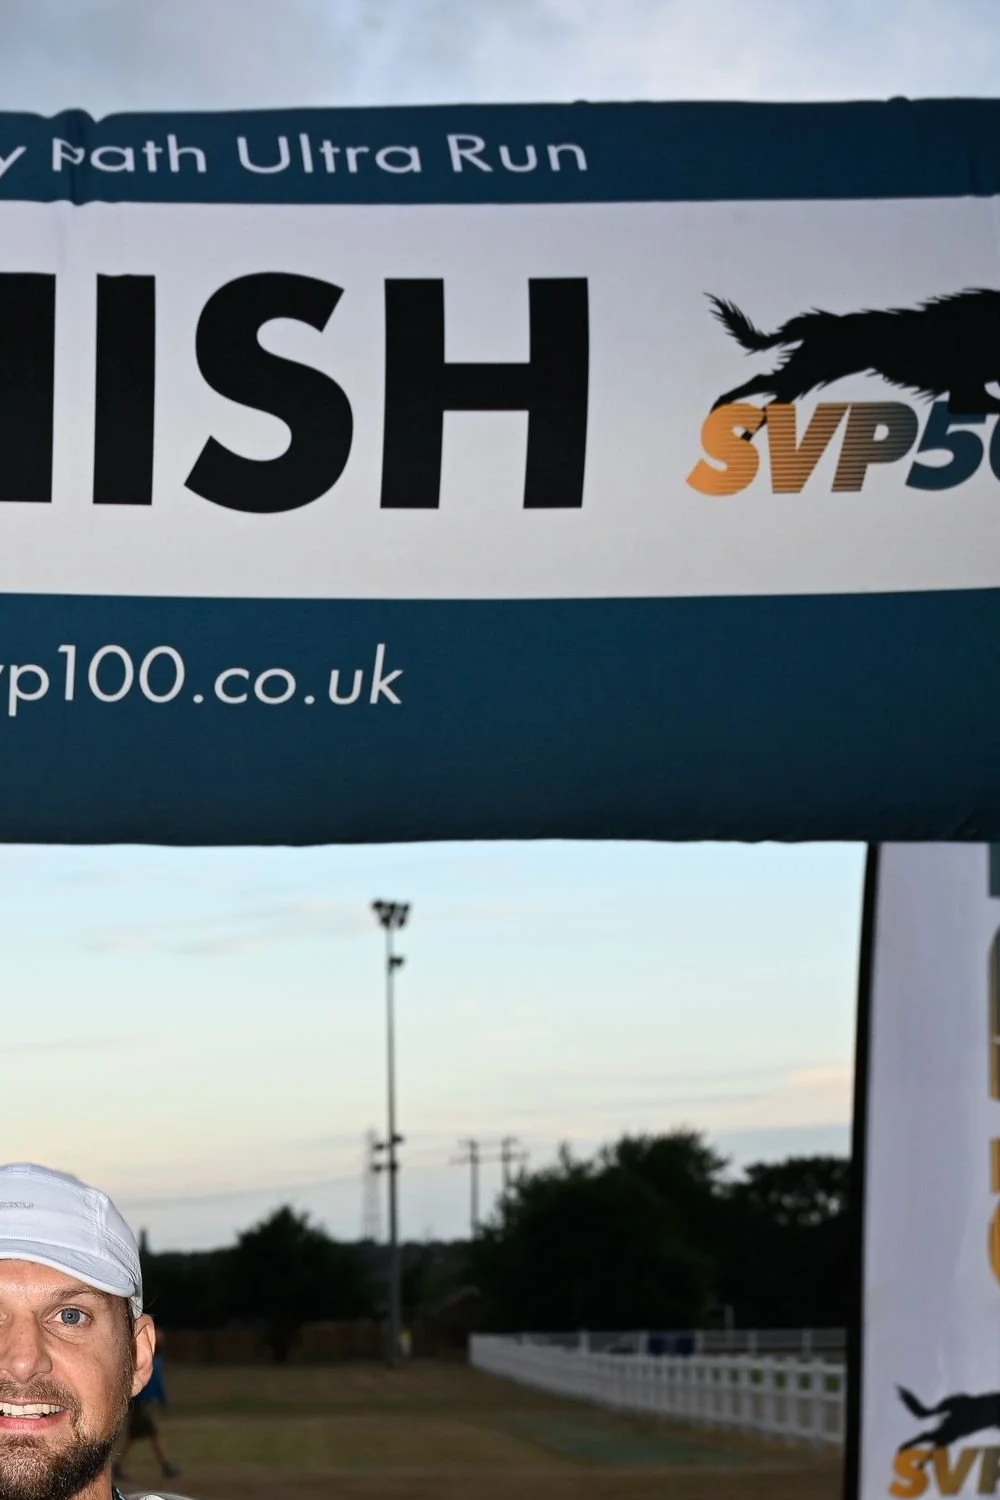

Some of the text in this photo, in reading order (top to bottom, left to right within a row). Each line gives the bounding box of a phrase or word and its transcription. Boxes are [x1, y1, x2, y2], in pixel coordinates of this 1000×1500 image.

[51, 133, 207, 174] Path
[236, 133, 422, 174] Ultra
[445, 134, 589, 173] Run
[684, 400, 1000, 497] SVP5
